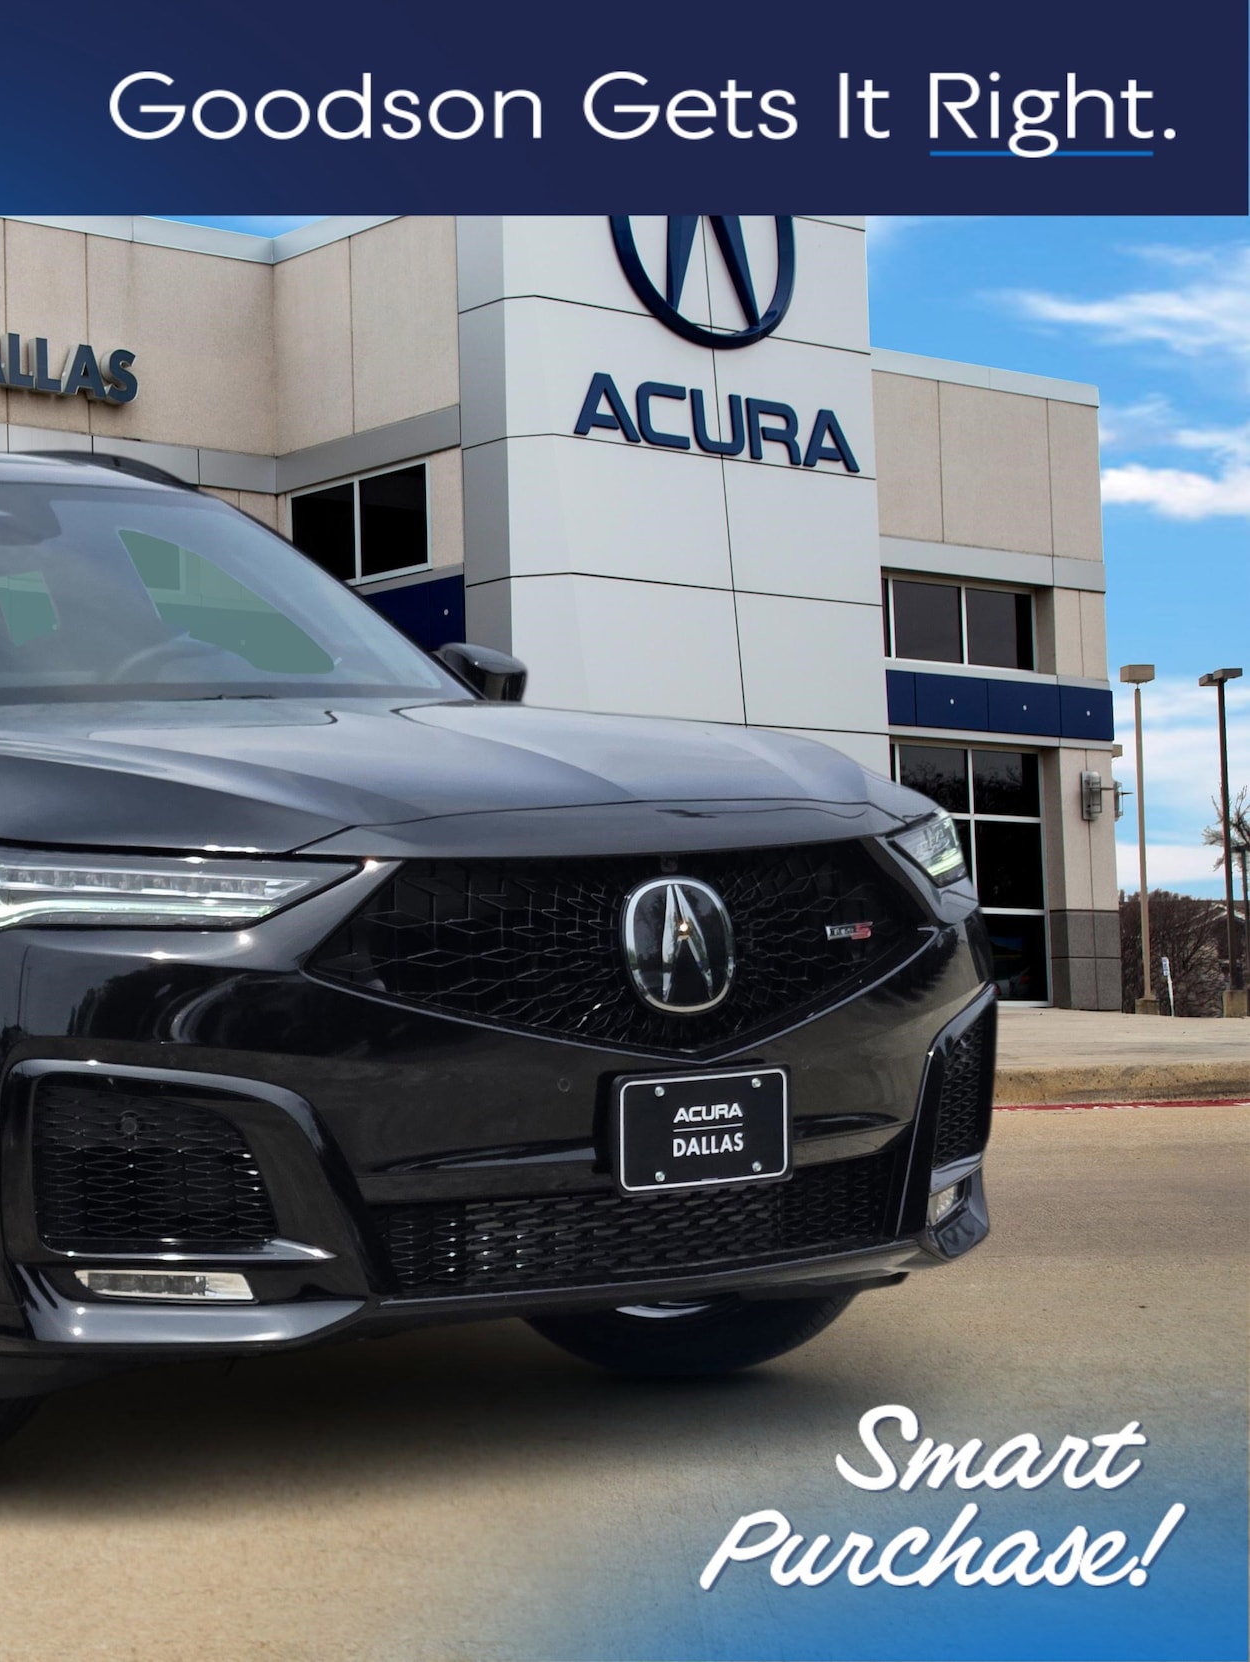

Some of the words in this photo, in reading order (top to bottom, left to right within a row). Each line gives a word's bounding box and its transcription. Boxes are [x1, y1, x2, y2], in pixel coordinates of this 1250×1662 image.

[573, 372, 860, 473] ACURA
[673, 1102, 743, 1124] ACURA
[672, 1132, 744, 1158] DALLAS
